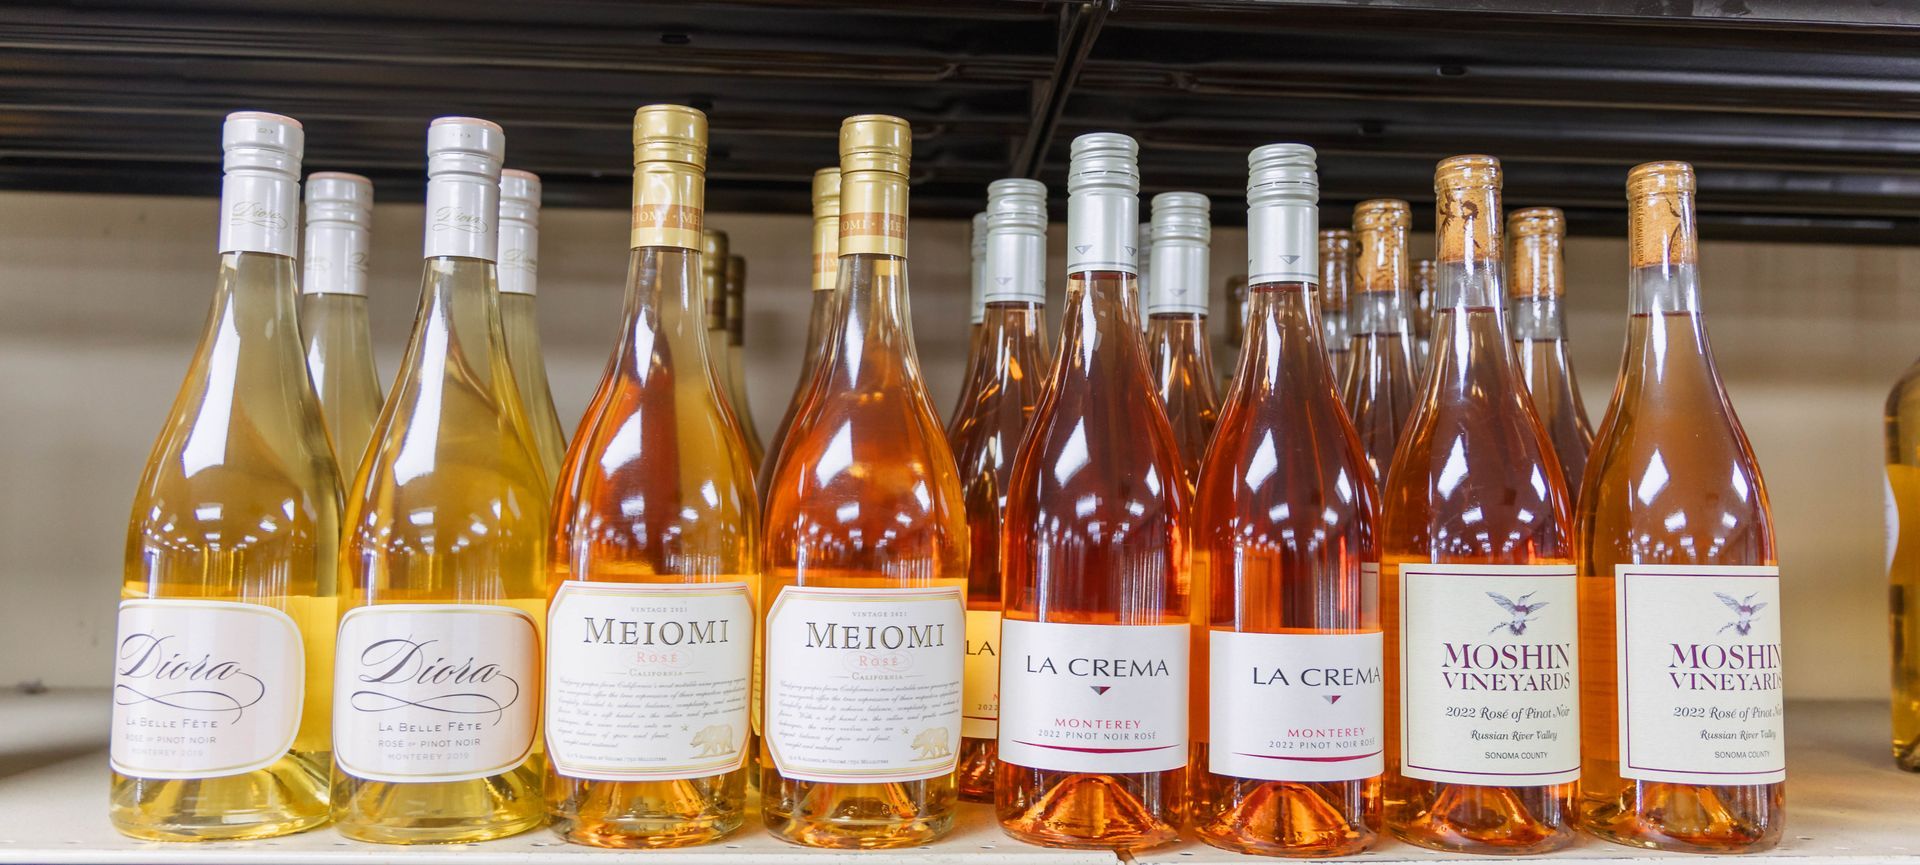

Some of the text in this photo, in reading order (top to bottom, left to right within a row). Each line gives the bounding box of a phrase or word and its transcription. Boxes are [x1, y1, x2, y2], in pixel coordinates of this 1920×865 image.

[583, 616, 729, 646] MEIOMI
[805, 622, 945, 650] MEIOMI
[965, 639, 996, 656] LA
[1441, 642, 1570, 670] MOSHIN
[117, 630, 263, 702] Diora
[355, 634, 517, 702] Diora
[1027, 655, 1169, 678] LA CREMA
[1253, 666, 1381, 687] LA CREMA
[1442, 672, 1571, 692] VINEYARDS
[1445, 706, 1476, 718] 2022
[1480, 706, 1508, 720] Rosé
[1511, 707, 1523, 722] of
[1526, 707, 1551, 719] Pinot
[1673, 706, 1705, 718] 2022
[1709, 706, 1737, 720] Rosé
[1739, 707, 1751, 722] of
[1752, 707, 1772, 719] Pinot
[139, 717, 176, 728] BELLE
[182, 718, 219, 729] FÊTE
[379, 720, 482, 733] LA BELLE FÊTE
[1055, 717, 1143, 730] MONTEREY
[1038, 729, 1157, 741] 2022 PINOT NOIR ROSÉ
[1288, 727, 1366, 738] MONTEREY
[1471, 729, 1558, 742] Russian River Valley
[1699, 729, 1737, 741] Russian
[1739, 729, 1760, 741] River
[156, 736, 185, 745] PINOT
[190, 735, 217, 745] NOIR
[420, 739, 452, 748] PINOT
[456, 738, 481, 748] NOIR
[1269, 740, 1294, 749] 2022
[1299, 741, 1331, 750] PINOT
[1335, 740, 1357, 749] NOIR
[388, 752, 443, 761] MONTEREY
[1484, 751, 1548, 760] SONOMA COUNTY
[1714, 750, 1770, 759] SONOMA COUNTY
